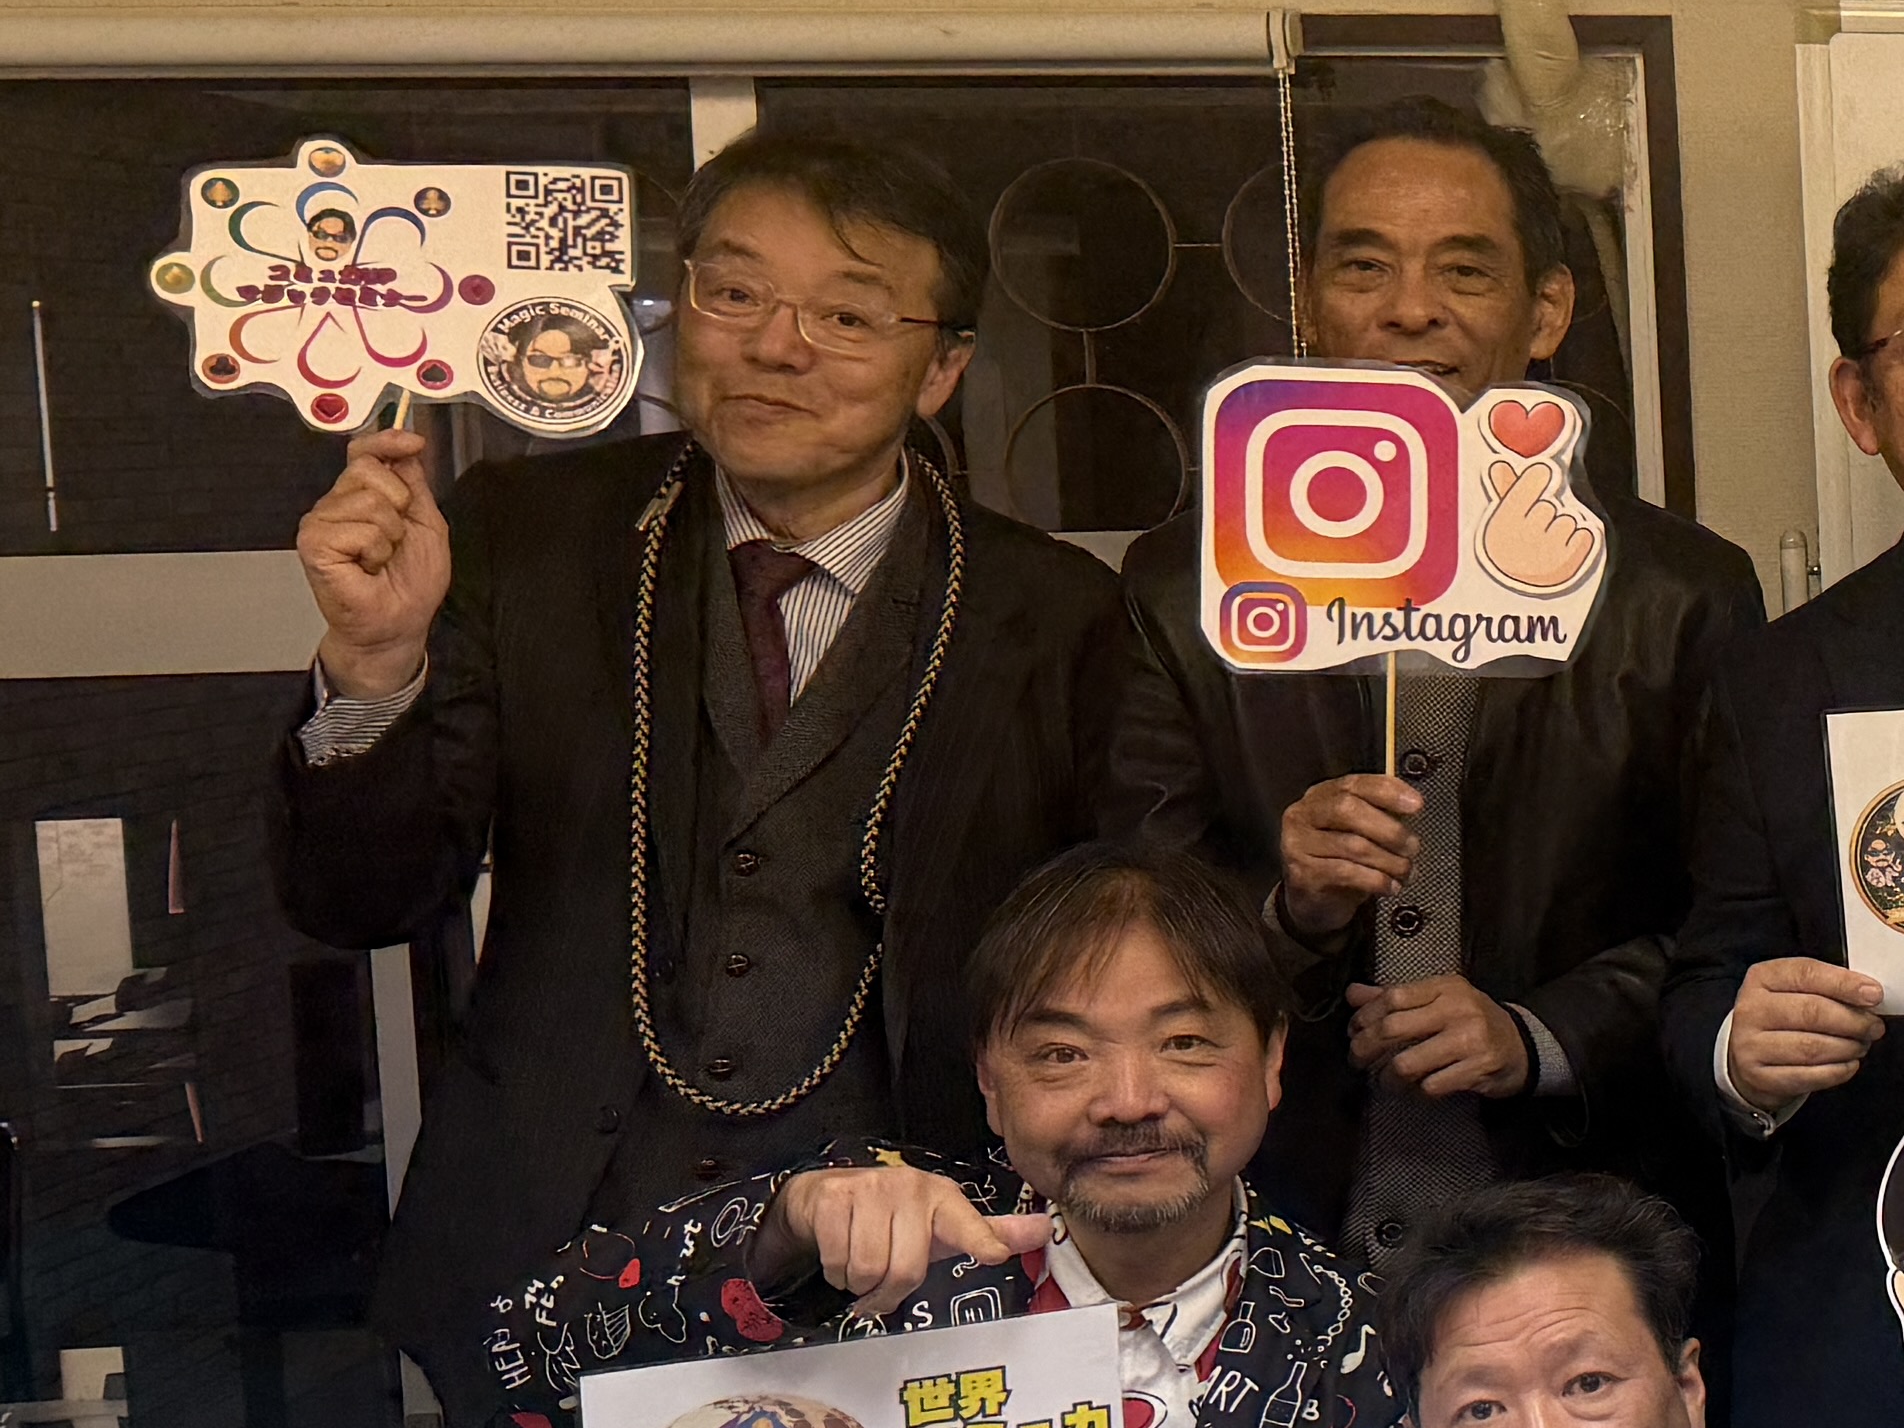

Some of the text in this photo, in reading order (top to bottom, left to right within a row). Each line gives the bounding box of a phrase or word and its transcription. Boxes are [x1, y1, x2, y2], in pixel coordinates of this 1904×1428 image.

[496, 302, 611, 341] Magic Seminar
[1326, 596, 1568, 663] Instagram
